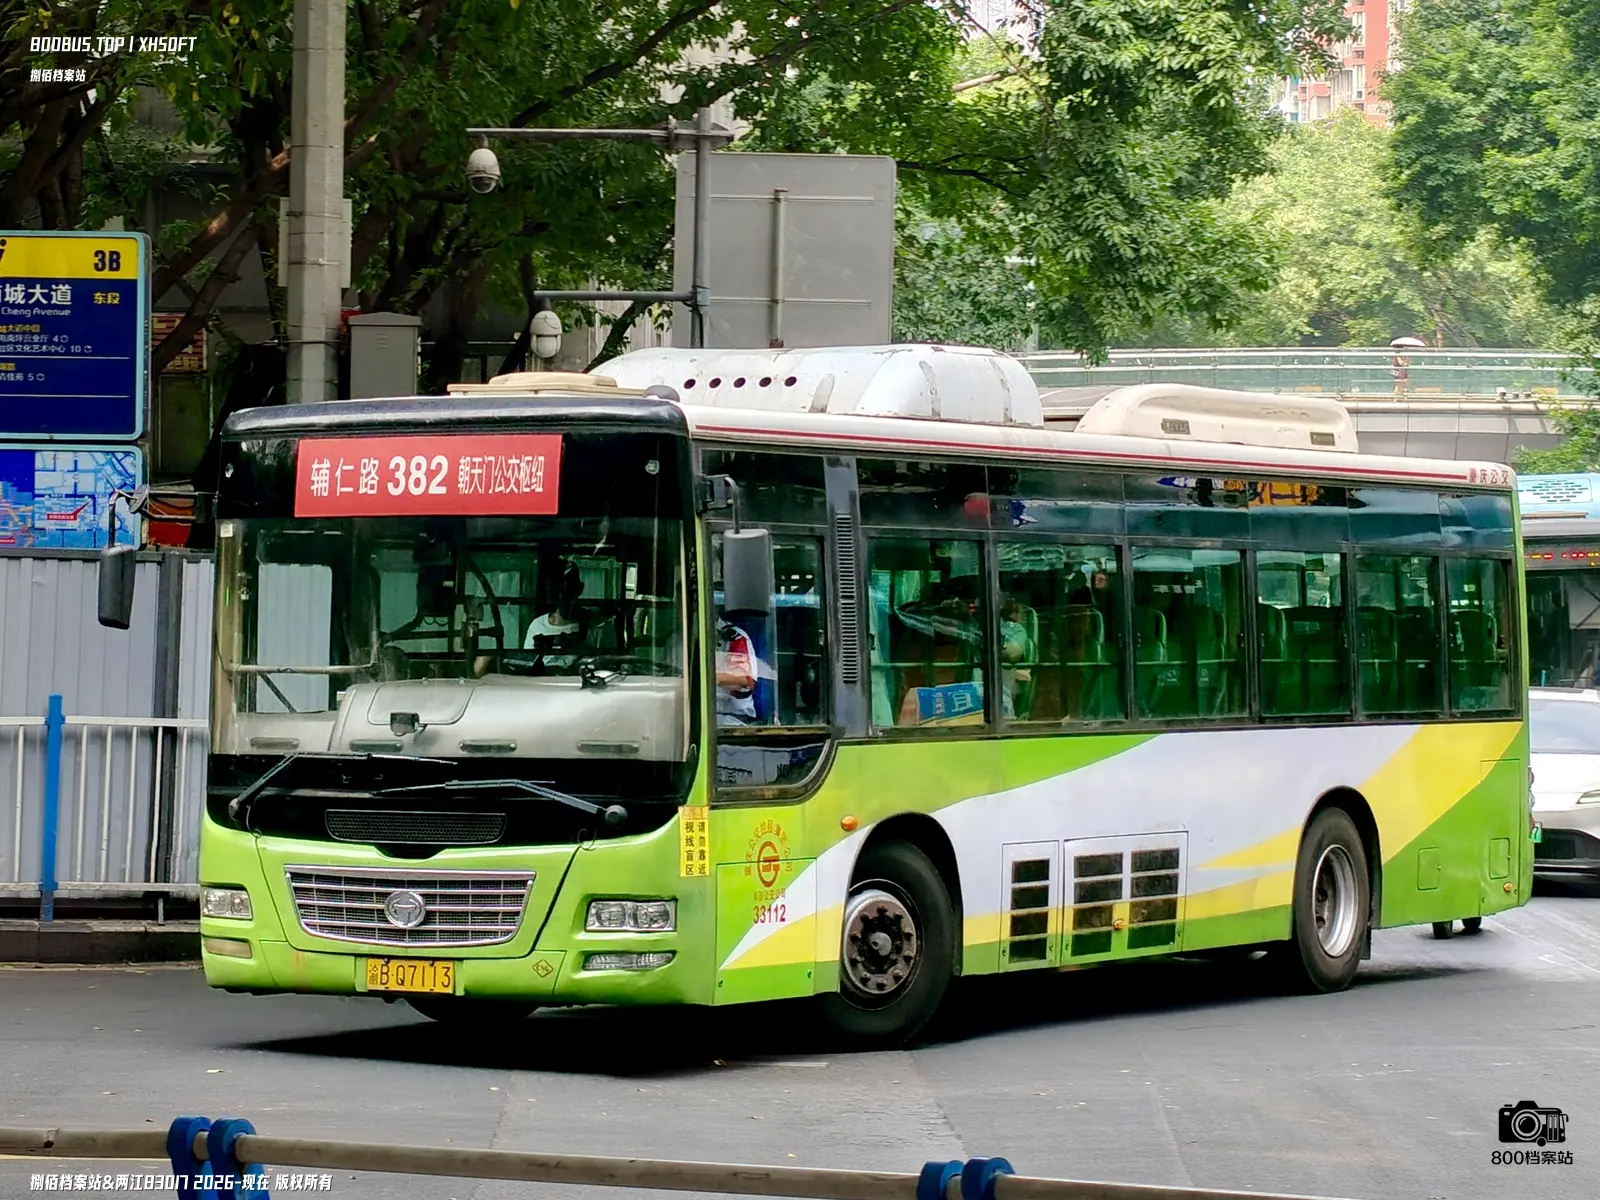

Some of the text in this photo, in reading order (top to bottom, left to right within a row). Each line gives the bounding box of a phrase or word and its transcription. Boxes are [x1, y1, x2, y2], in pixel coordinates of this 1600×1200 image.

[93, 249, 121, 272] 3B
[0, 283, 72, 305] 城大道
[93, 292, 120, 304] 东段
[1, 306, 71, 317] Cheng Avenue
[53, 335, 59, 343] 4
[70, 345, 82, 353] 10
[27, 373, 34, 381] 5
[310, 454, 545, 497] 辅仁路 382 朝天门公交枢纽
[1468, 467, 1509, 485] 重庆公交
[684, 821, 695, 876] 视线盲区
[697, 821, 707, 875] 请勿靠近
[752, 903, 786, 924] 33112
